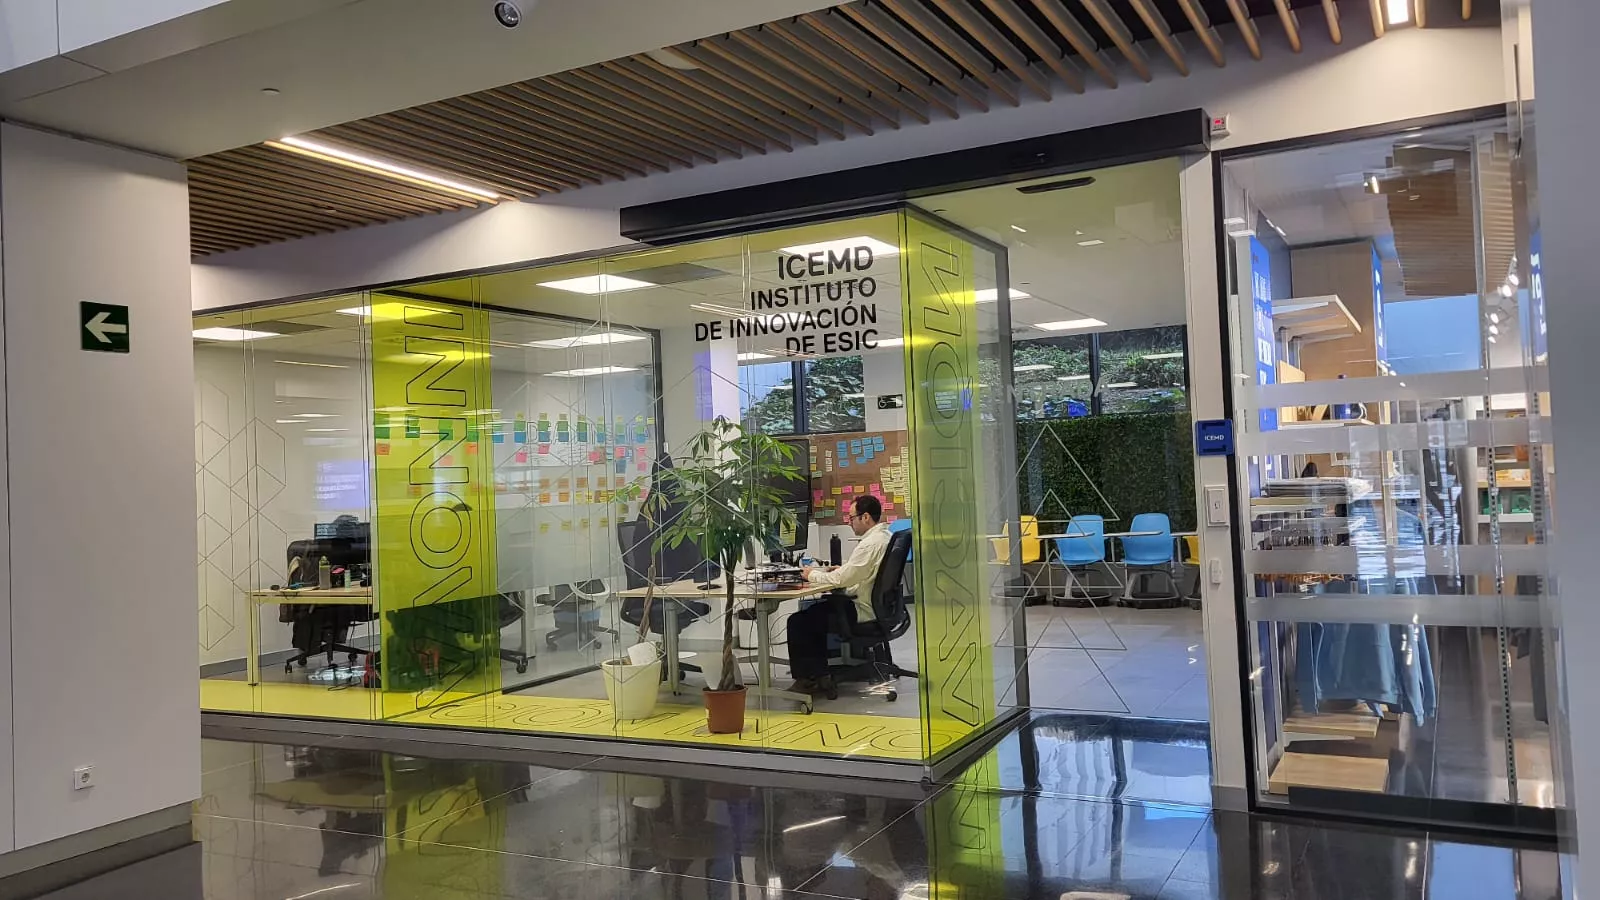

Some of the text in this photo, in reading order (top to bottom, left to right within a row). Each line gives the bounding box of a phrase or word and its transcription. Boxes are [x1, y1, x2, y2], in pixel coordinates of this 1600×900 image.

[778, 245, 874, 280] ICEMD
[751, 276, 877, 310] INSTITUTO
[695, 300, 877, 342] DE INNOVACIÓN
[786, 328, 878, 357] DE ESIC
